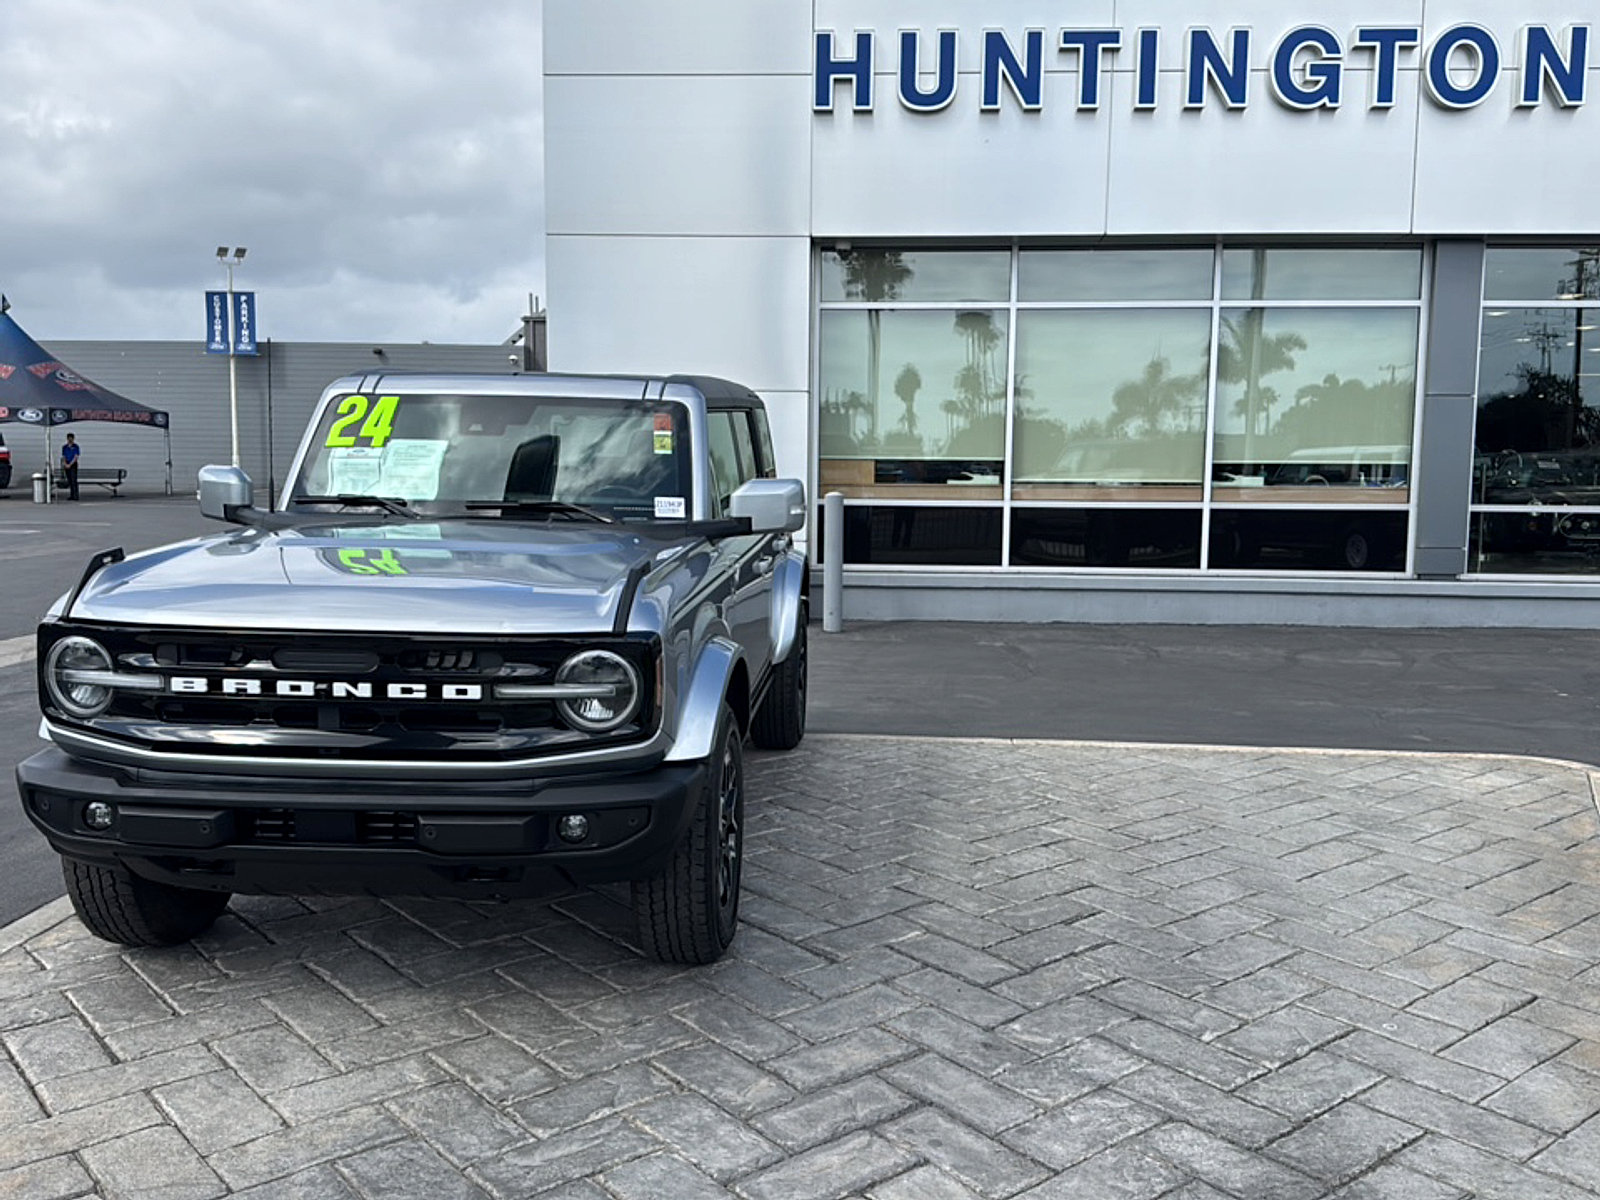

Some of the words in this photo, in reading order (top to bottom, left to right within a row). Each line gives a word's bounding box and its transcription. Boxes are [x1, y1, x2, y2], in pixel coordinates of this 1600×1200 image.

[813, 24, 1589, 111] HUNTINGTON
[240, 295, 250, 343] PARKING
[325, 395, 400, 447] 24
[170, 676, 482, 700] BRONCO
